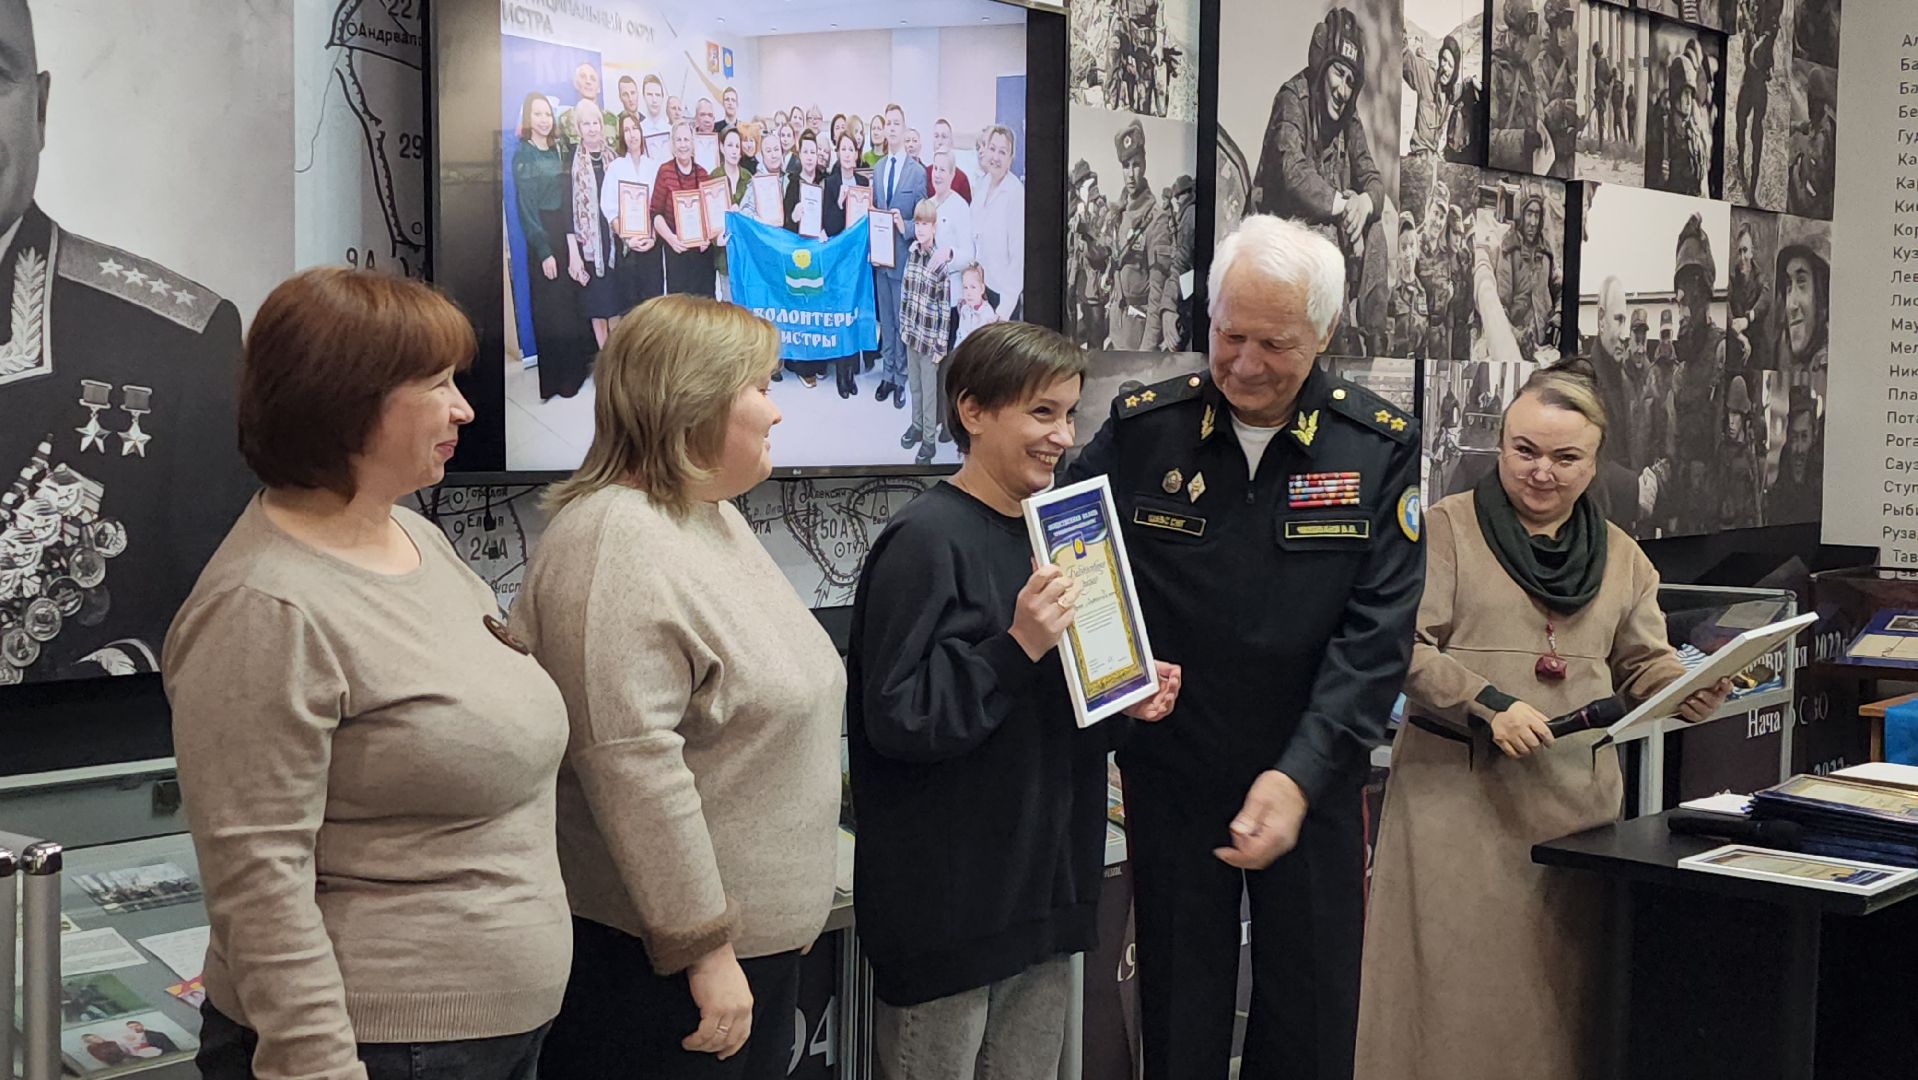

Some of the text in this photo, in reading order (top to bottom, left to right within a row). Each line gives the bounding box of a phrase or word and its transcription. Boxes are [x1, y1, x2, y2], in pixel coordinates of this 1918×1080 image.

[502, 2, 555, 34] ИСТРА
[1900, 57, 1918, 71] Ба
[1899, 81, 1918, 95] Ба
[1898, 104, 1918, 119] Бе
[1890, 270, 1918, 284] Лев
[1890, 294, 1918, 307] Лис
[781, 331, 837, 348] ИСТРЫ
[1890, 341, 1918, 355] Мел
[1893, 549, 1918, 563] Тав
